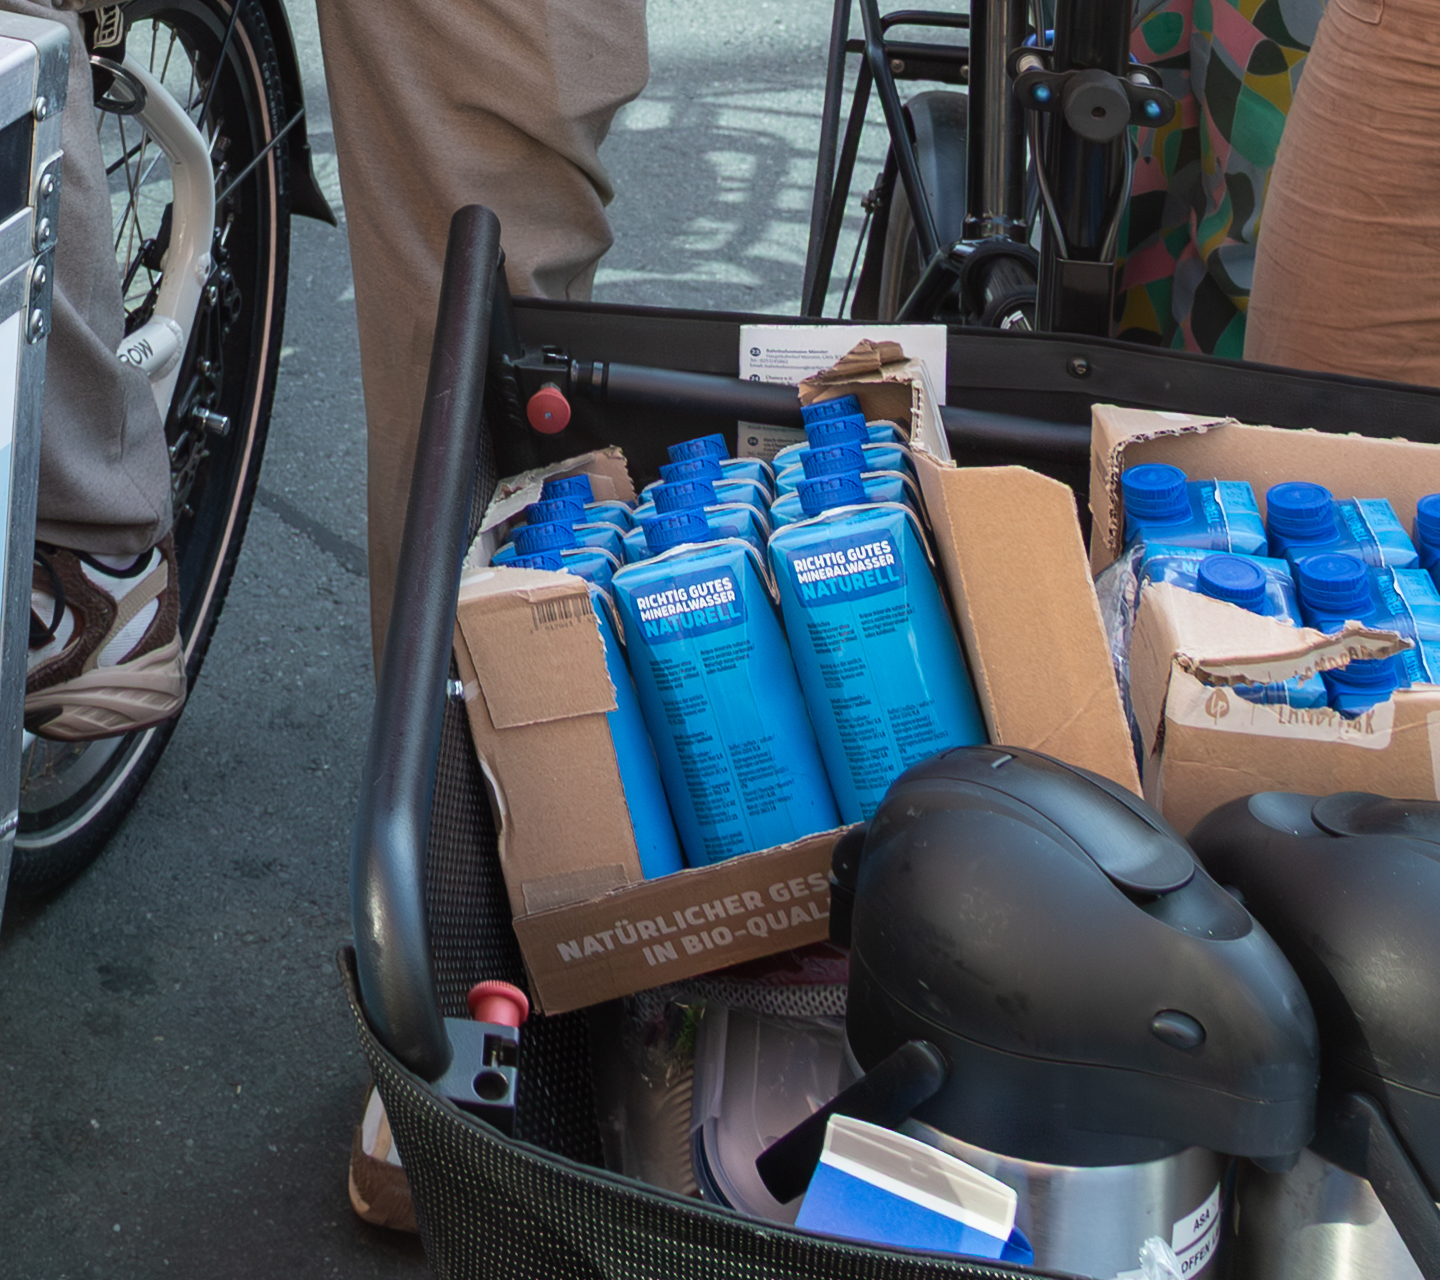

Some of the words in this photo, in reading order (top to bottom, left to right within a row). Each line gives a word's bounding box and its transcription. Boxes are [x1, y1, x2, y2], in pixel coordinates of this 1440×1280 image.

[793, 552, 846, 573] RICHTIG
[846, 540, 892, 562] GUTES
[797, 553, 895, 583] MINERALWASSER
[636, 587, 687, 611] RICHTIG
[688, 576, 732, 599] GUTES
[800, 567, 900, 601] NATURELL
[639, 590, 736, 622] MINERALWASSER
[643, 602, 742, 639] NATURELL
[556, 890, 765, 962] NATÜRLICHER
[768, 870, 832, 903] GES
[642, 940, 679, 966] IN
[680, 899, 832, 956] BIO-QUAL
